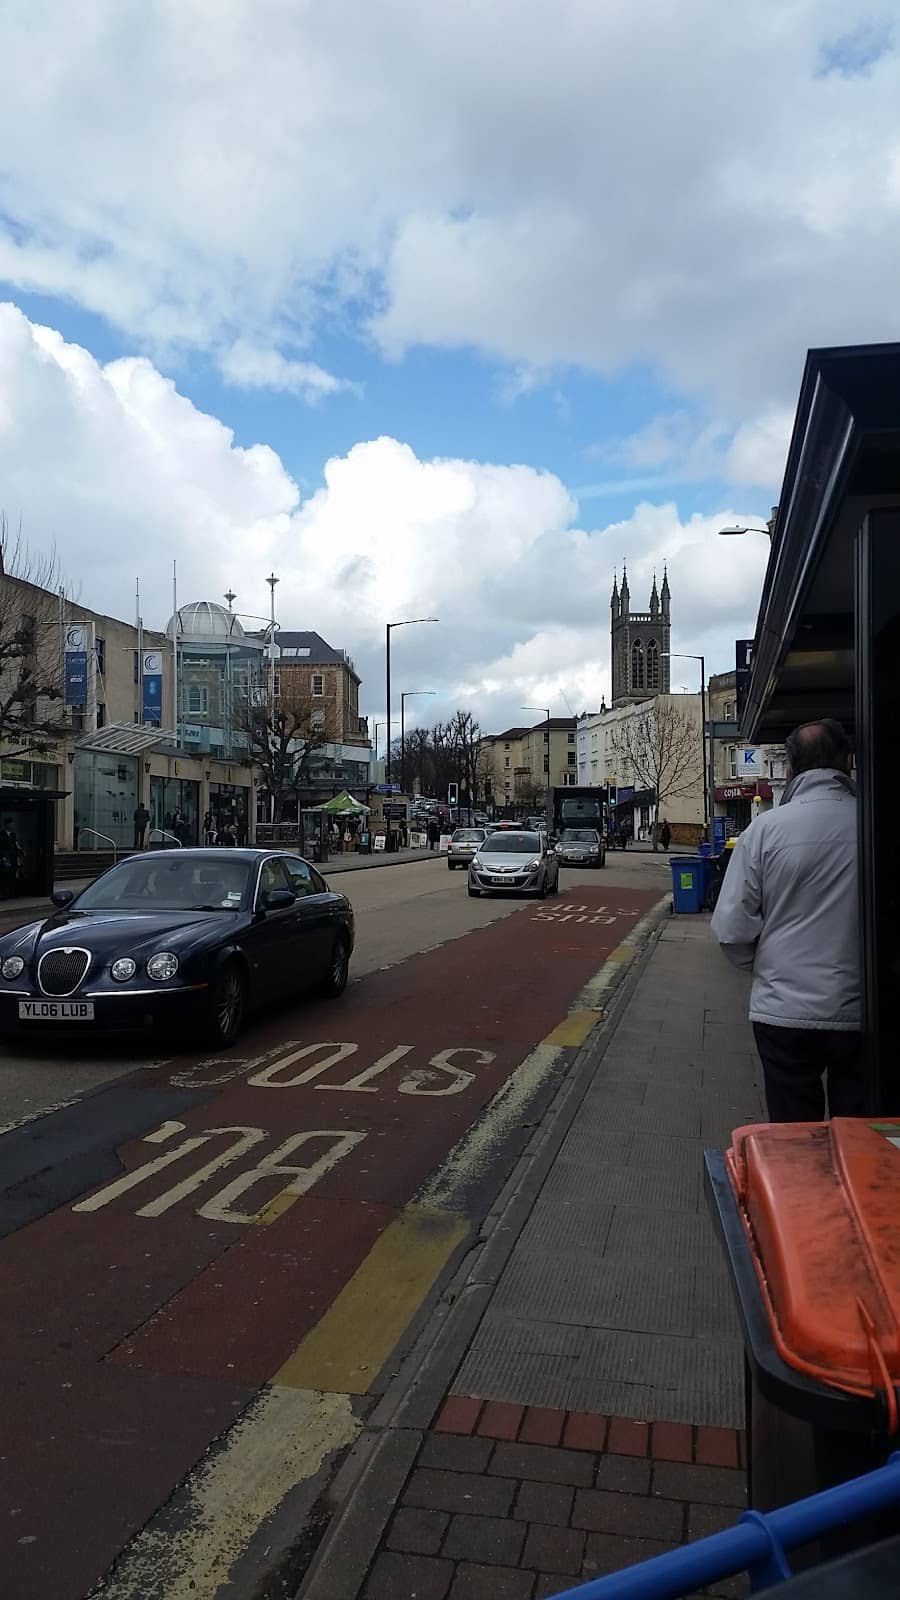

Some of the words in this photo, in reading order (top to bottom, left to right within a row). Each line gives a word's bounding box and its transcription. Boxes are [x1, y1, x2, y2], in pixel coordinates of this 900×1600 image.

[744, 750, 756, 764] K
[723, 787, 742, 798] COSTA
[536, 903, 641, 916] STOP
[530, 912, 617, 925] BUS
[24, 1003, 58, 1017] YL06
[61, 1004, 88, 1017] LUB
[71, 1119, 371, 1227] BU
